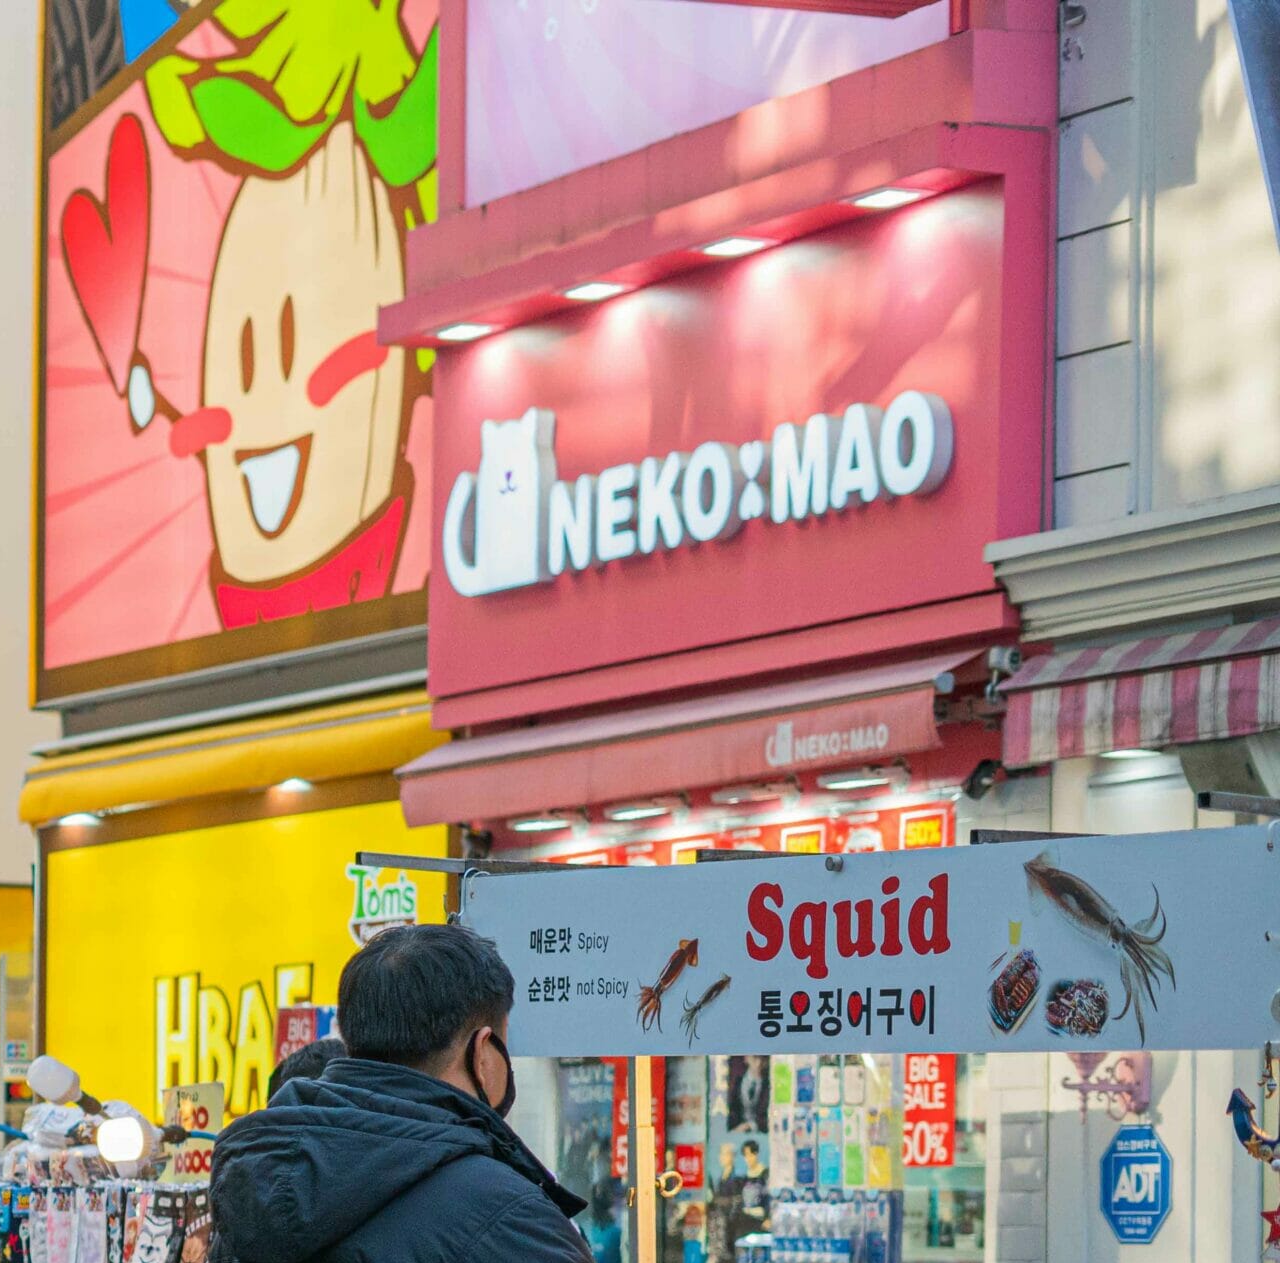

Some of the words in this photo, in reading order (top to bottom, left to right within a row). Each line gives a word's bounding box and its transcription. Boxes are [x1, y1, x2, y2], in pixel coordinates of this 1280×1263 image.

[349, 868, 415, 918] Tom's
[530, 927, 572, 954] 매운맛
[577, 932, 609, 953] Spicy
[746, 873, 951, 979] Squid
[528, 976, 571, 1002] 순한맛
[576, 983, 594, 996] not
[597, 977, 629, 999] Spicy
[758, 985, 935, 1038] 통오징어구이
[909, 1054, 940, 1082] BIG
[903, 1081, 947, 1111] SALE
[1113, 1162, 1161, 1203] ADT
